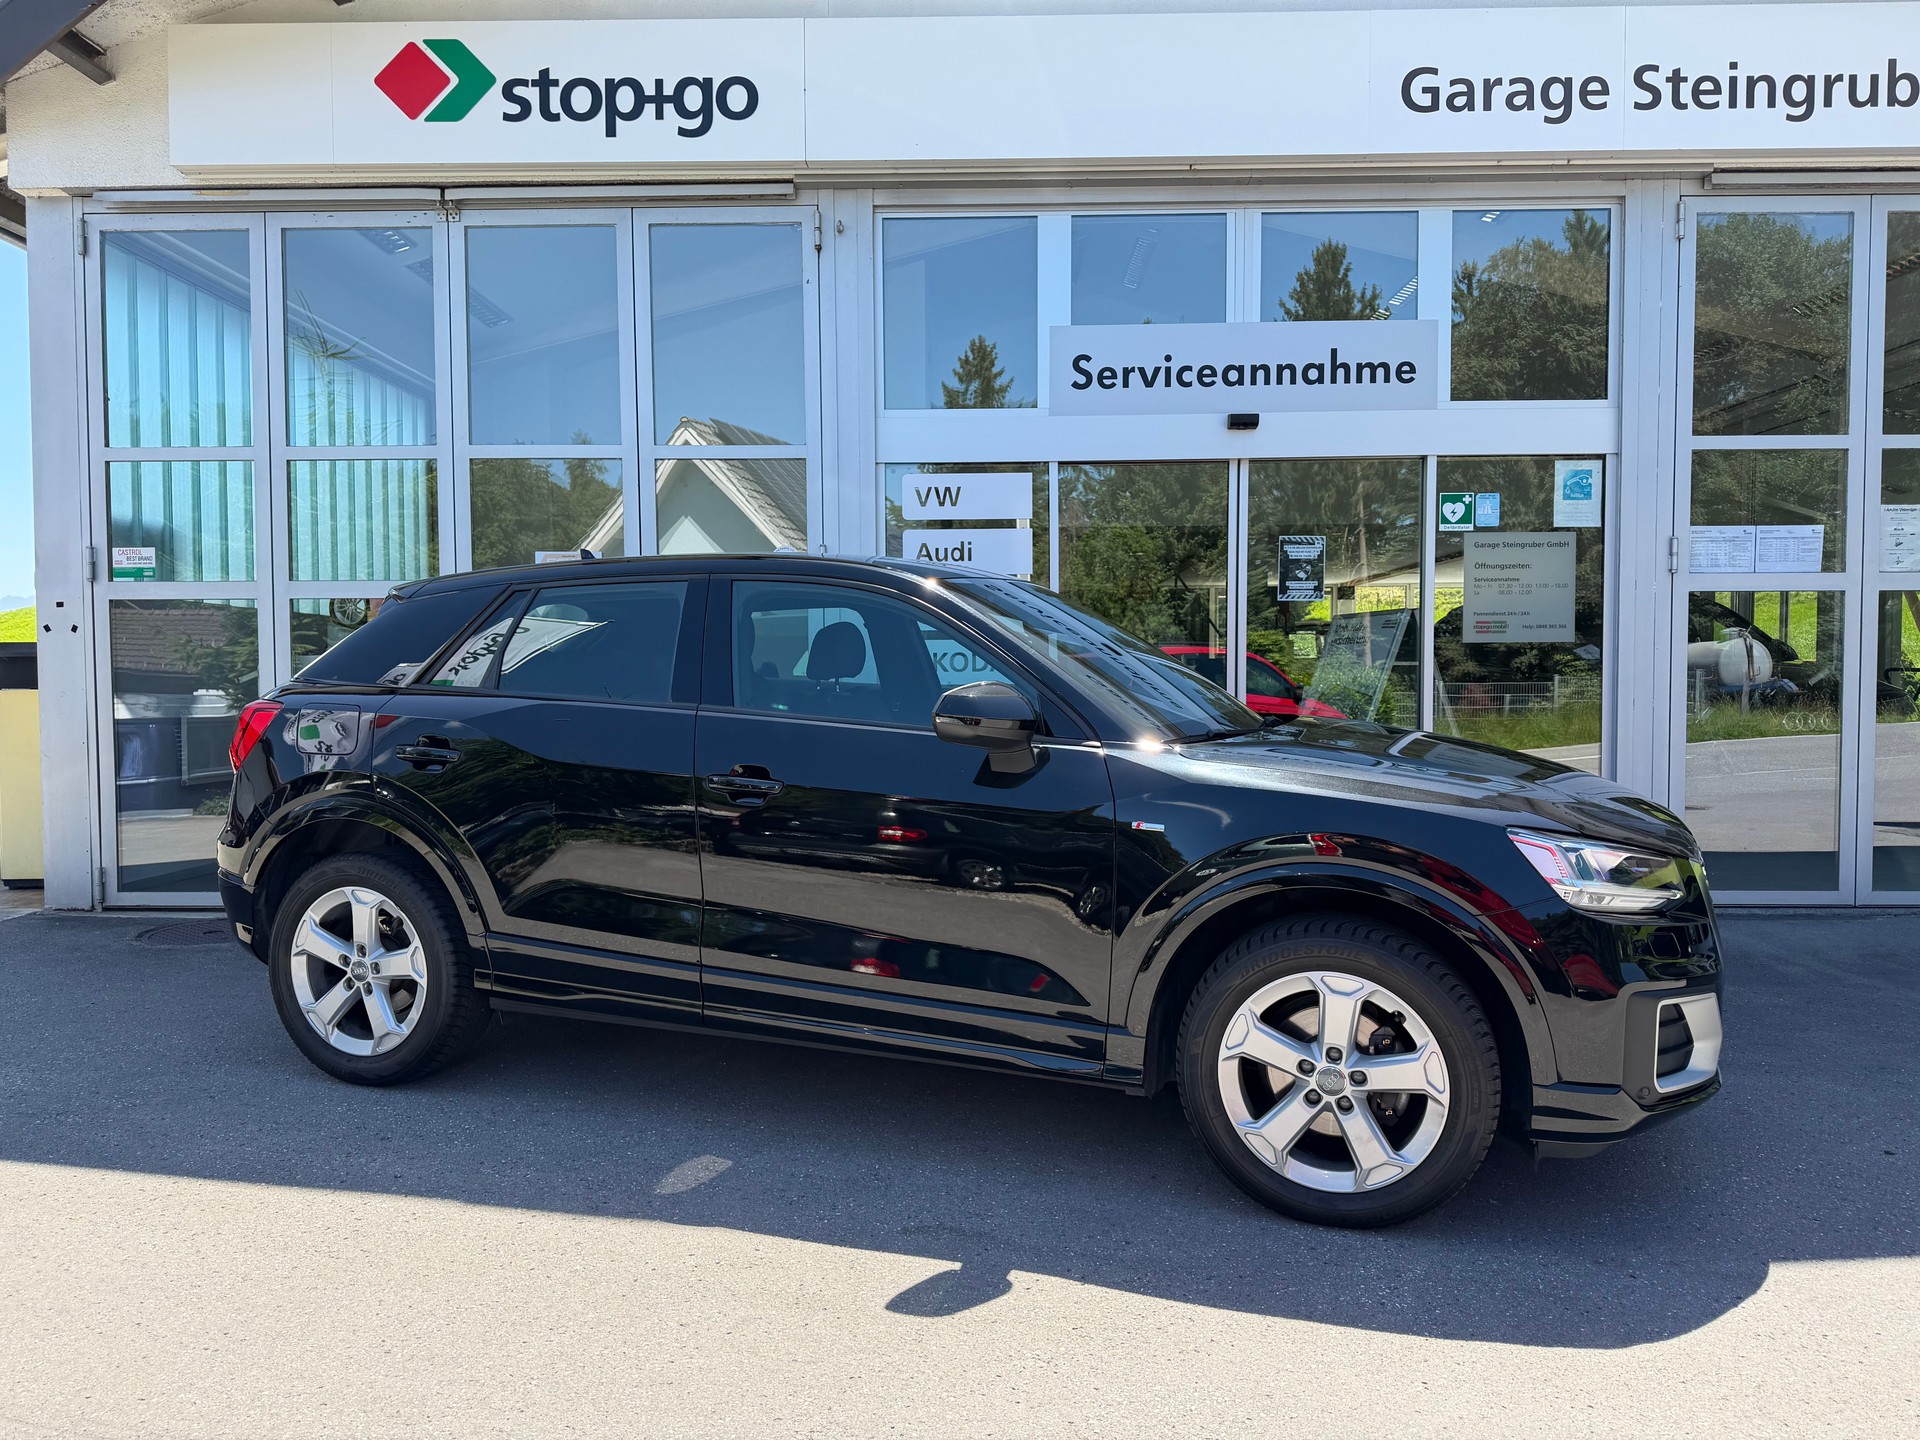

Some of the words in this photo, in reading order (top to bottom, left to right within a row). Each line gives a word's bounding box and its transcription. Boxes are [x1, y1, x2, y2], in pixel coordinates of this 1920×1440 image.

[1401, 66, 1610, 125] Garage
[1632, 58, 1920, 122] Steingrub
[501, 67, 759, 138] stop+go
[1070, 347, 1417, 390] Serviceannahme
[914, 486, 962, 507] VW
[915, 541, 973, 562] Audi
[1474, 541, 1500, 550] Garage
[1502, 541, 1545, 550] Steingruber
[1474, 561, 1532, 571] Öffnungszeiten:
[932, 652, 994, 673] KOD
[1240, 944, 1363, 976] BRIDGESTONE
